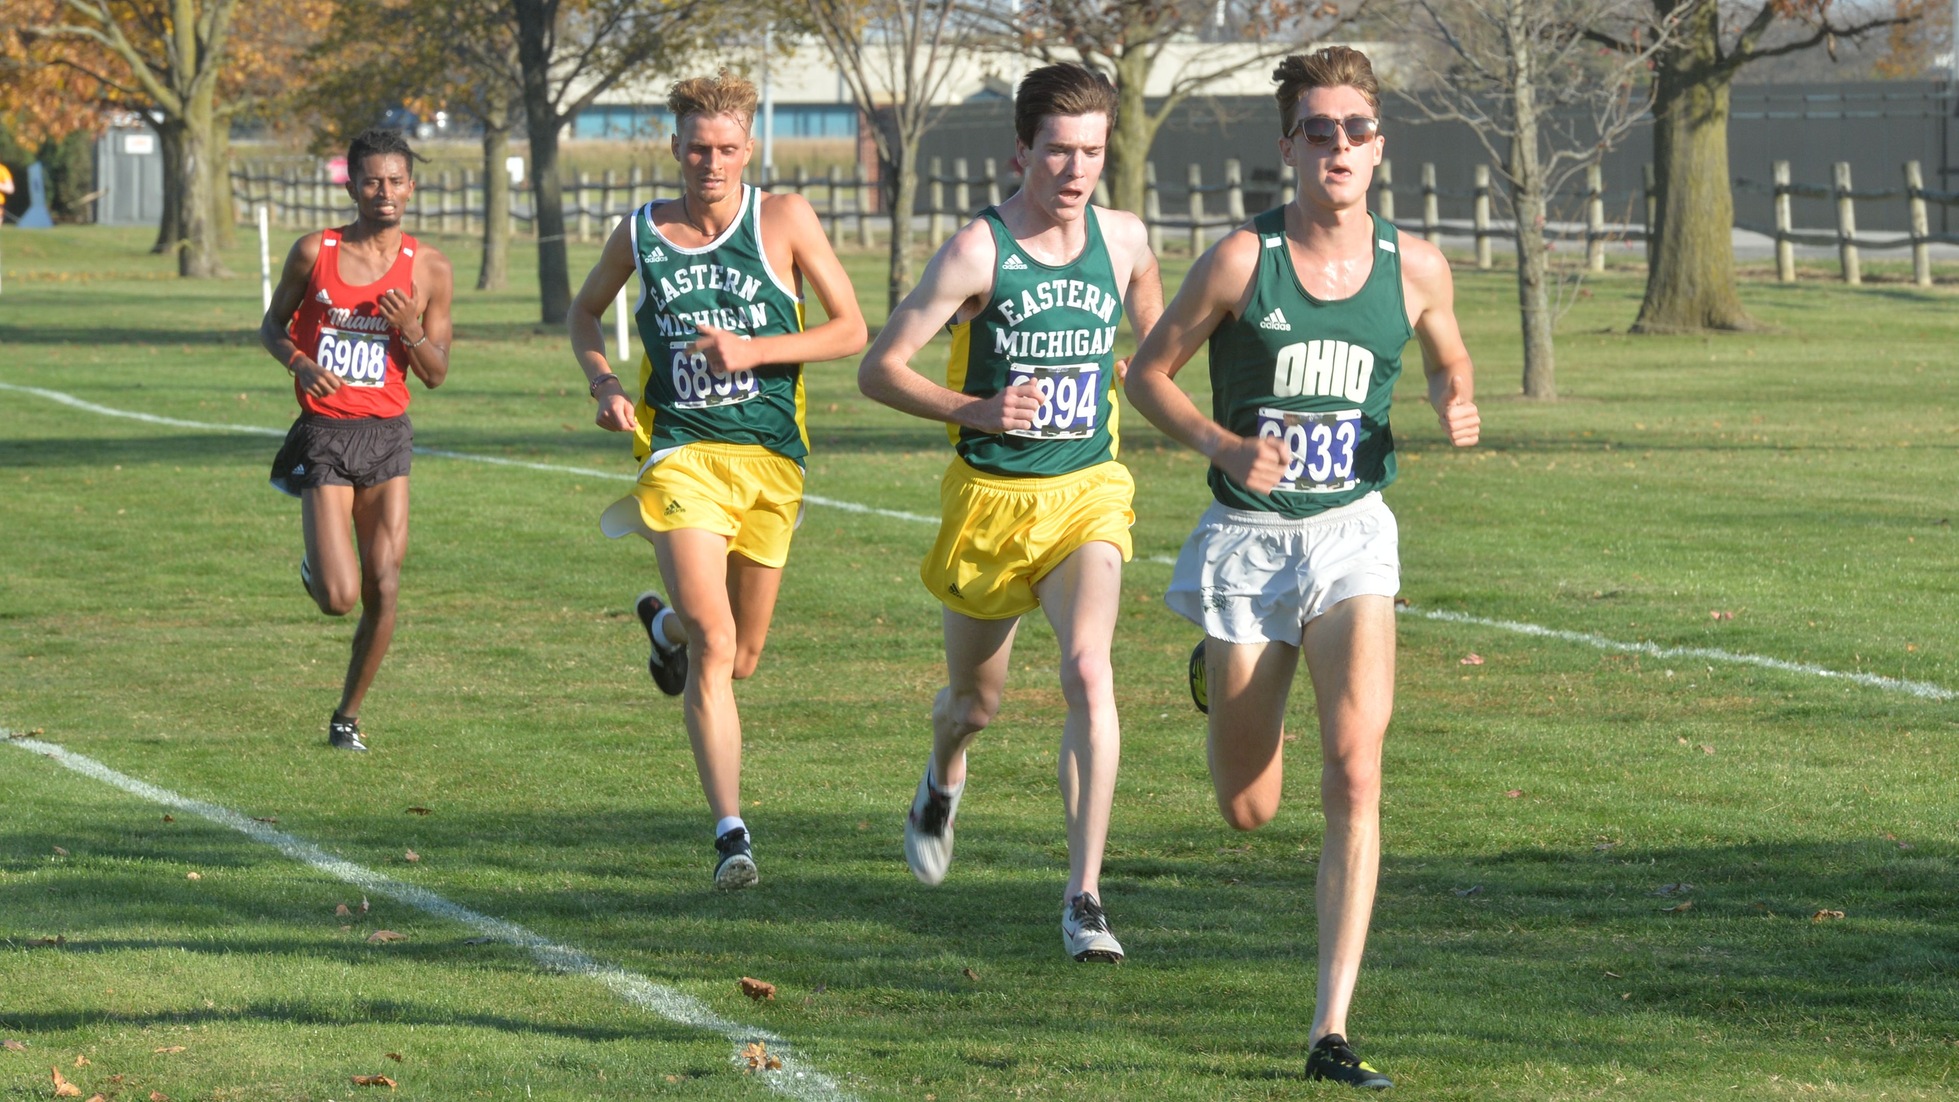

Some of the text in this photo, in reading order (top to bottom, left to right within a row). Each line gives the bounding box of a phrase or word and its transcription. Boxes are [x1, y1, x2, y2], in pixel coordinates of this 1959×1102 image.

[644, 255, 669, 264] adidas
[650, 264, 762, 312] EASTERN
[998, 279, 1117, 327] EASTERN
[328, 307, 390, 331] Miami
[655, 302, 767, 337] MICHIGAN
[1259, 320, 1291, 331] adidas
[317, 335, 385, 380] 6908
[994, 326, 1117, 358] MICHIGAN
[1273, 339, 1375, 404] OHIO
